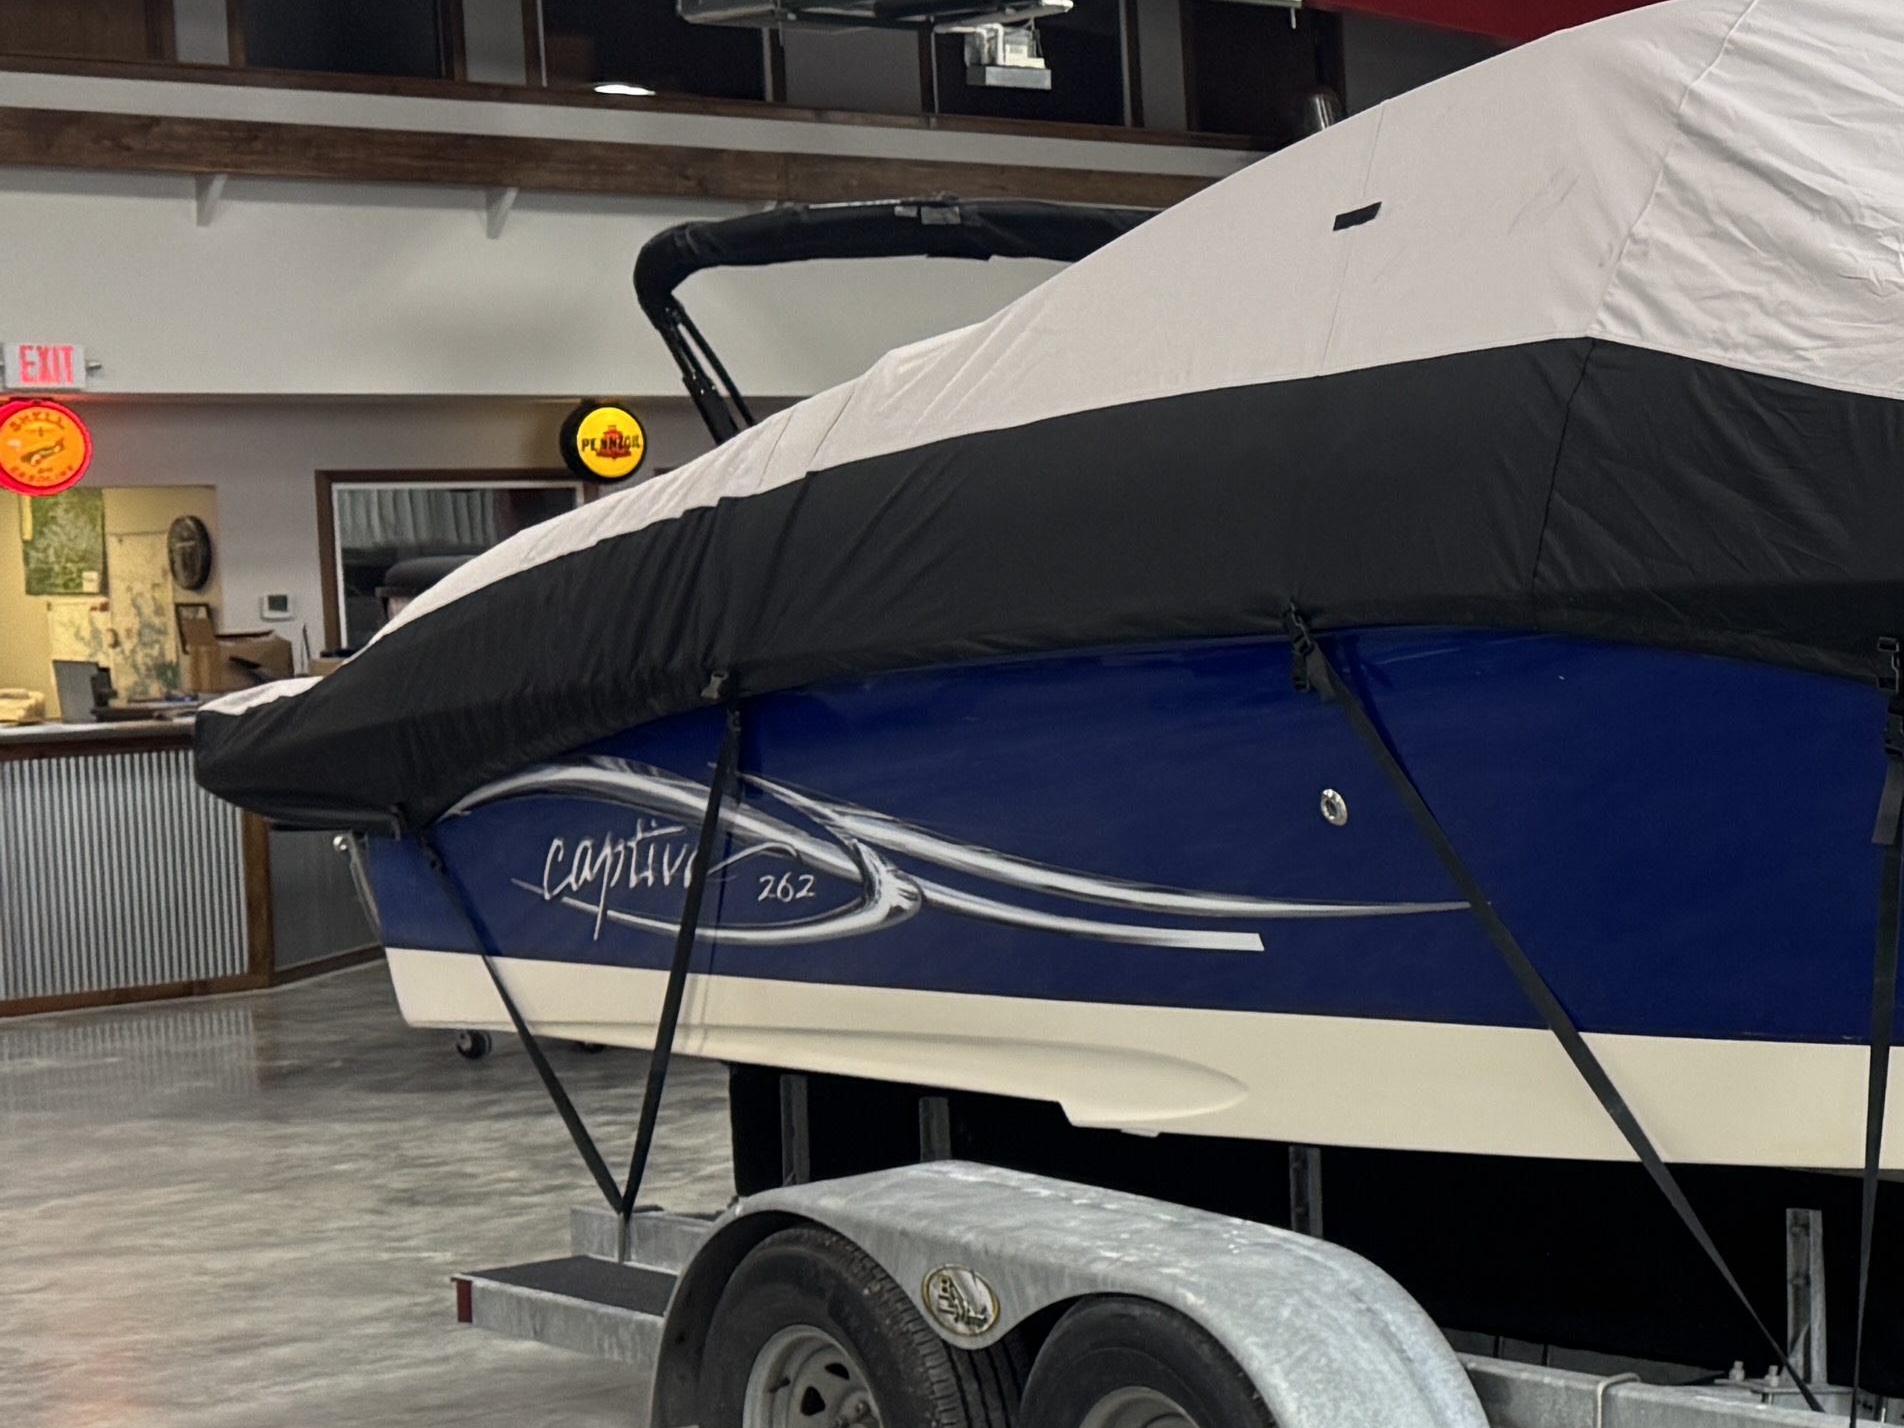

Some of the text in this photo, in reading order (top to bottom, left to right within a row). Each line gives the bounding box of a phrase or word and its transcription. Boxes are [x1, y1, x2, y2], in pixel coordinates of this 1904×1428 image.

[19, 345, 74, 385] EXIT
[9, 411, 65, 432] SHELL
[581, 435, 640, 452] PENNZOIL
[758, 873, 815, 902] 262
